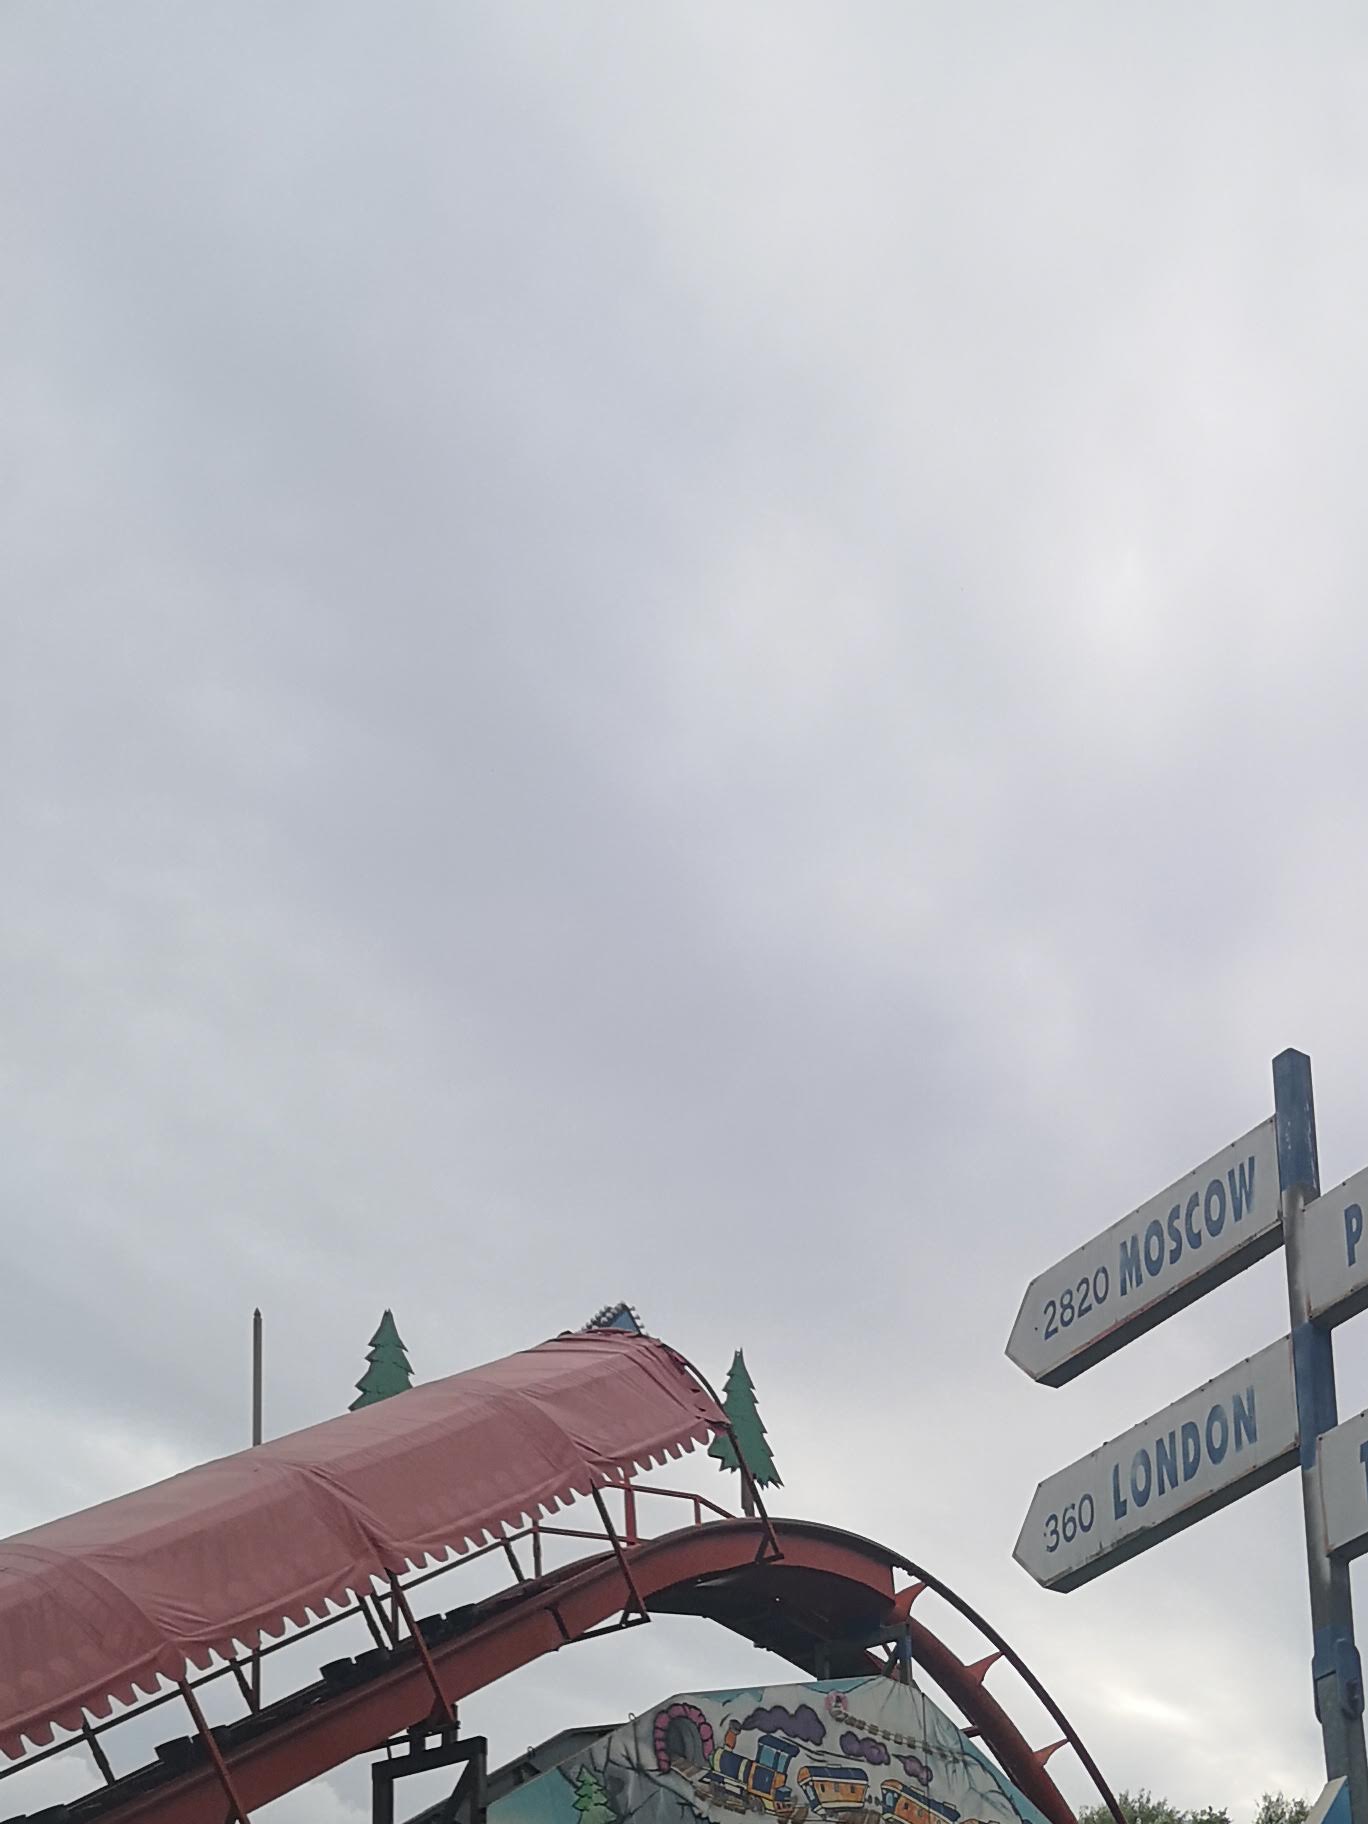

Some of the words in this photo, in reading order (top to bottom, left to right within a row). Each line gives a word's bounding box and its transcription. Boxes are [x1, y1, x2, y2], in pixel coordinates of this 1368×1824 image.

[1043, 1266, 1110, 1341] 2820
[1119, 1155, 1256, 1297] MOSCOW
[1045, 1493, 1095, 1553] 360
[1112, 1385, 1258, 1521] LONDON
